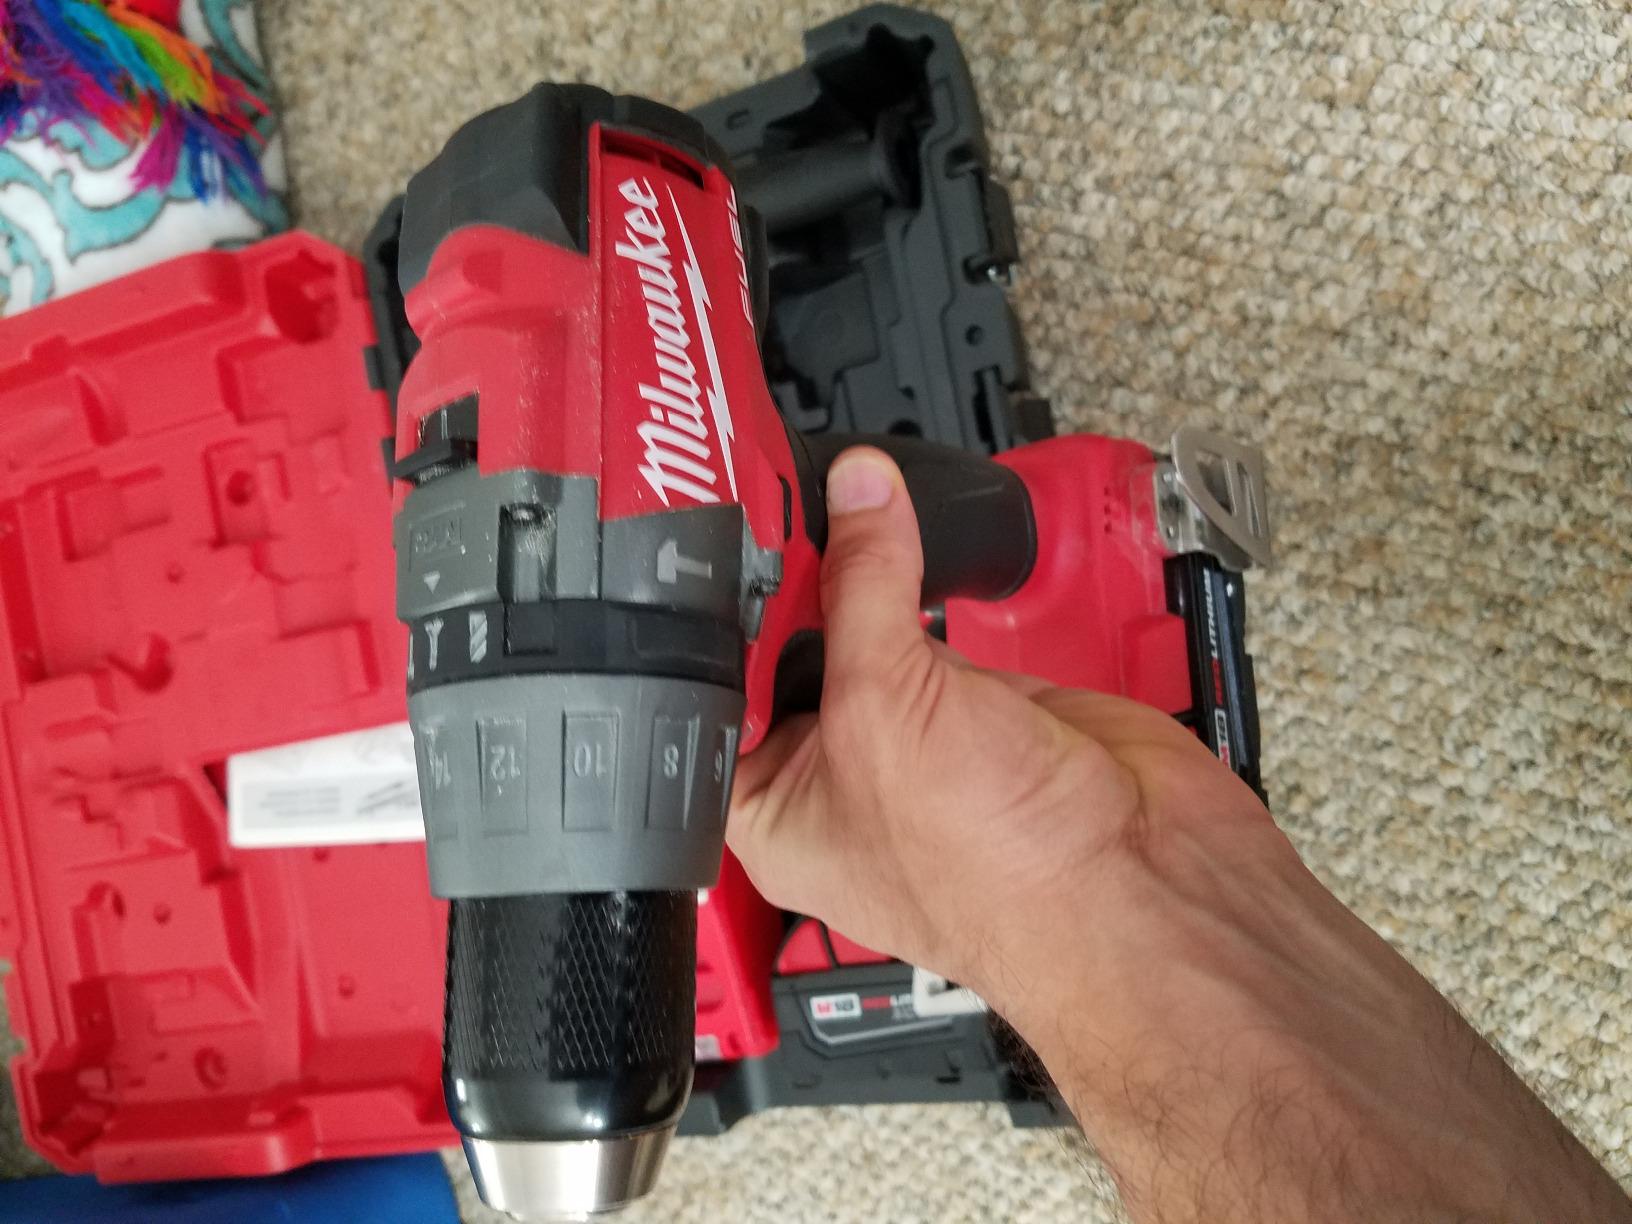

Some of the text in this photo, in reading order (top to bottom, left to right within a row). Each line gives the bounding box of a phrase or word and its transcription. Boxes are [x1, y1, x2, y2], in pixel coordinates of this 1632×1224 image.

[726, 183, 754, 329] FUEL
[615, 176, 720, 508] Milwaukee
[490, 744, 521, 781] 12
[573, 741, 607, 778] 10
[662, 743, 680, 779] 8
